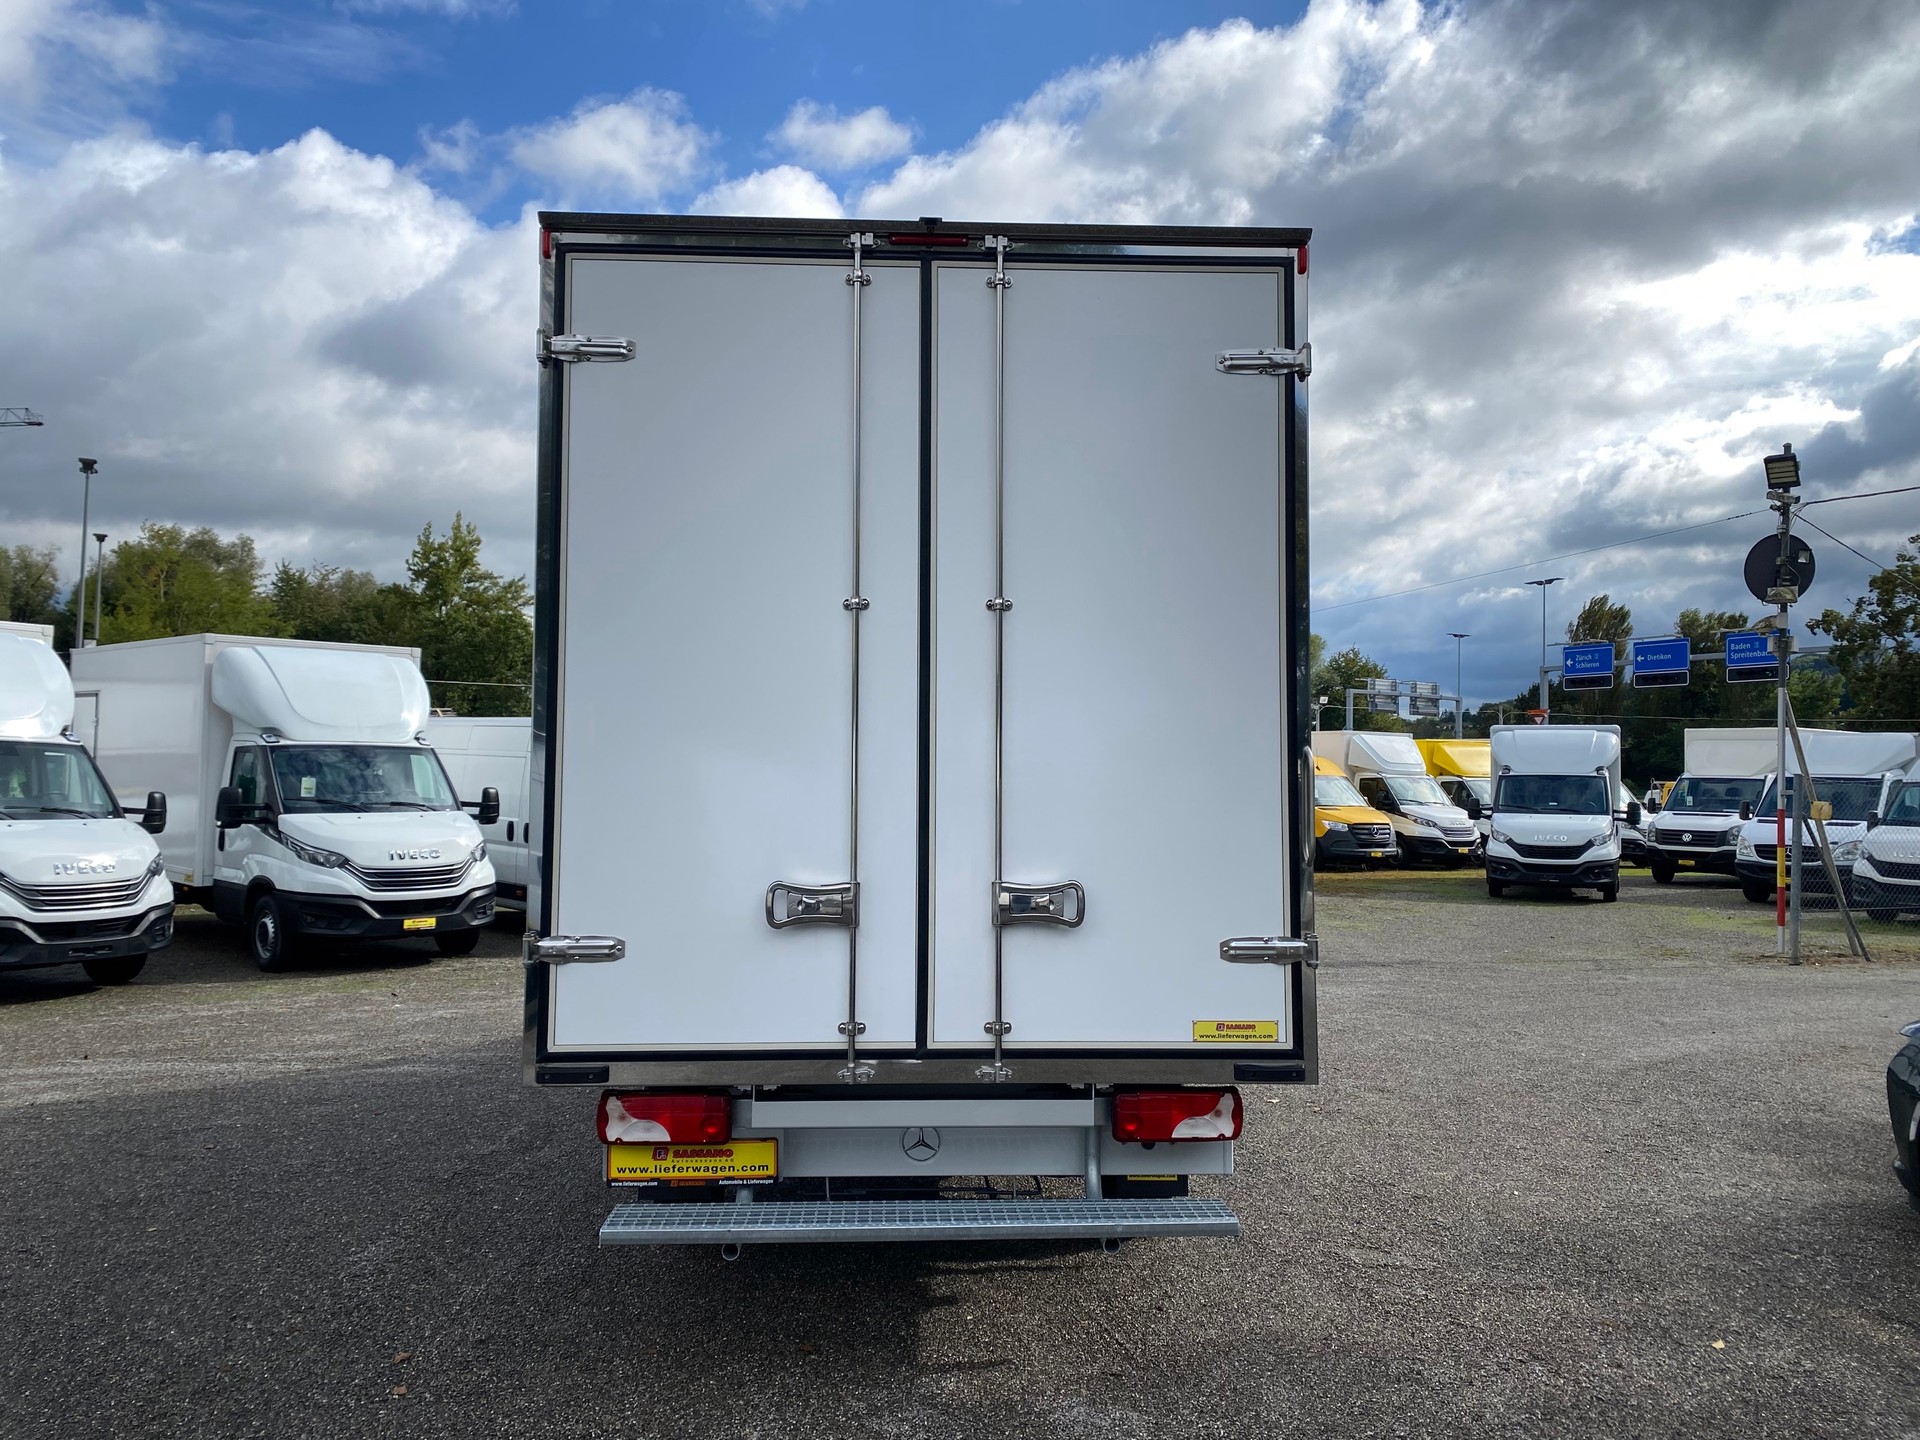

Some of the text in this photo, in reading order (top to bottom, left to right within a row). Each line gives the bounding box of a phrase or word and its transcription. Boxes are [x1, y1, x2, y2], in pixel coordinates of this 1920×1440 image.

[1730, 643, 1751, 651] Baden
[1647, 653, 1672, 661] Dietikon
[1730, 650, 1772, 660] Spreitenbac
[1575, 661, 1600, 669] Schlieren
[1534, 834, 1568, 842] IVECO
[388, 848, 441, 861] IVECO
[53, 861, 116, 875] IVECO
[672, 1148, 734, 1158] SASSANO
[616, 1164, 769, 1174] www.lieferwagen.com
